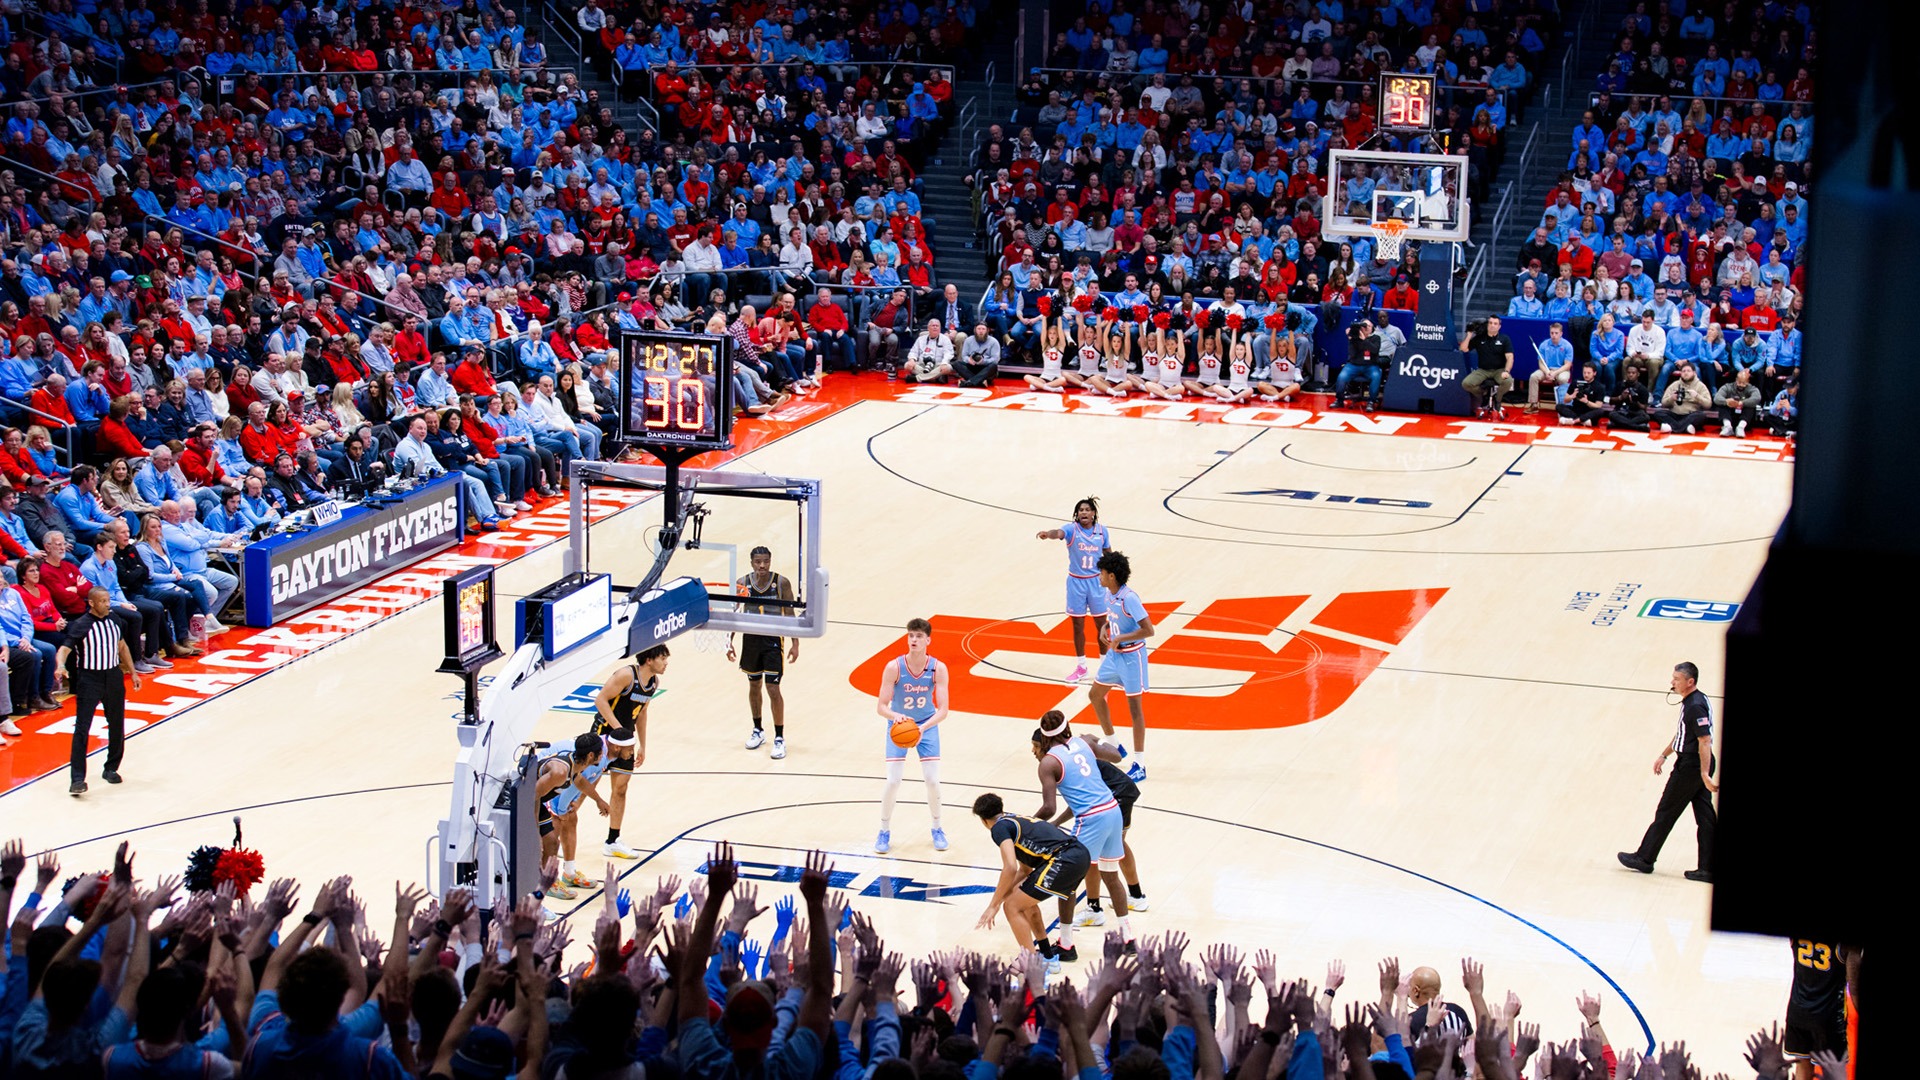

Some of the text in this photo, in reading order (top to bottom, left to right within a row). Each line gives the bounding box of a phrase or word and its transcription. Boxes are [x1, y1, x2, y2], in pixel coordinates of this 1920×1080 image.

[1391, 79, 1430, 95] 12:27
[1391, 96, 1424, 124] 30
[1415, 323, 1446, 333] Premier
[1417, 332, 1444, 341] Health
[644, 344, 713, 374] 12:27
[1399, 354, 1459, 389] Kroger
[644, 376, 704, 430] 30
[896, 386, 1796, 462] DAYTON FLYE
[647, 432, 696, 441] DAKTRONICS
[315, 502, 338, 520] WHIO
[271, 496, 458, 605] DAYTON FLYERS
[1081, 556, 1094, 569] 11
[1564, 591, 1602, 611] BANK
[653, 611, 688, 639] altafiber
[903, 683, 929, 694] Dayton
[631, 704, 643, 720] 4
[903, 696, 927, 709] 29
[1073, 753, 1092, 777] 3
[1797, 939, 1832, 971] 23
